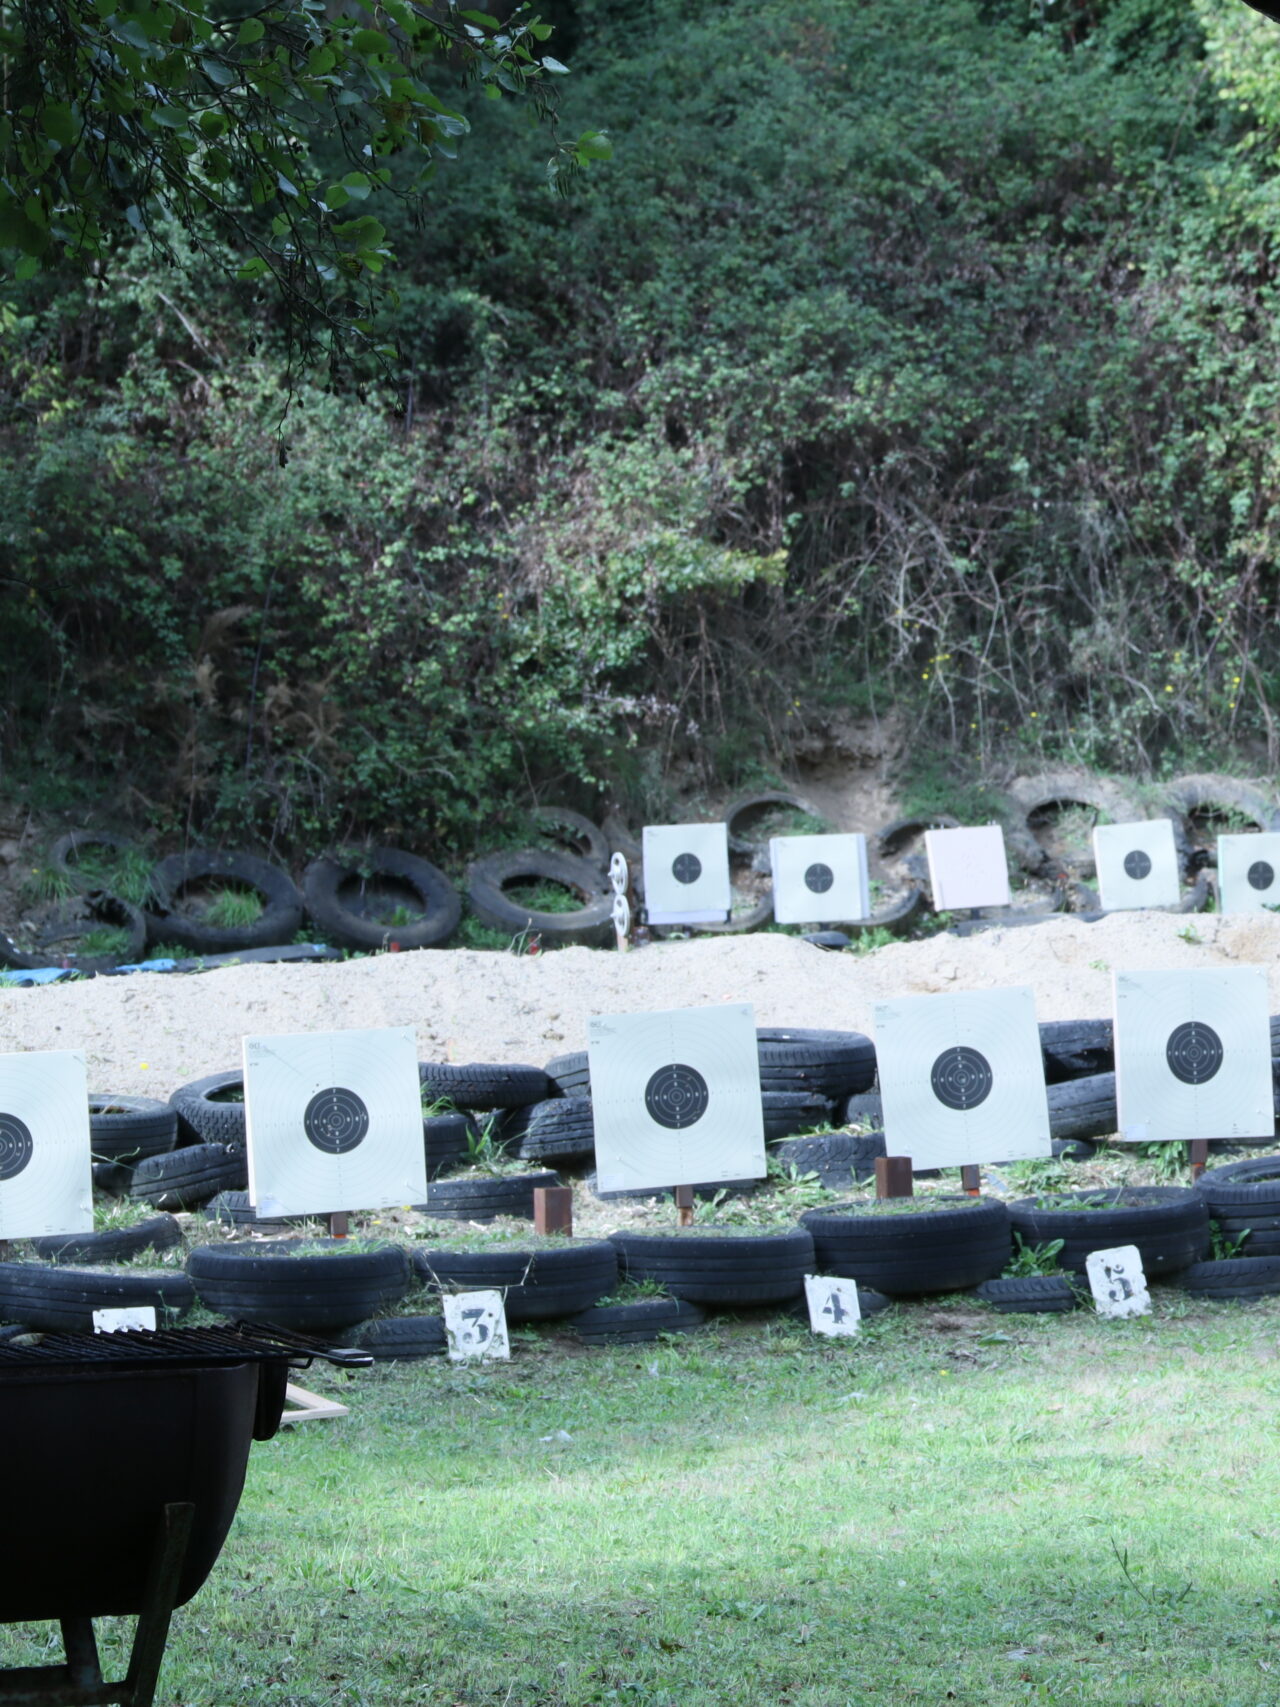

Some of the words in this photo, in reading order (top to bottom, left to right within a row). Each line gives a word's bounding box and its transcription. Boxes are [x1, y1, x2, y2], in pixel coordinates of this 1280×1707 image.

[1104, 1264, 1134, 1302] 5
[460, 1307, 490, 1345] 3
[822, 1291, 849, 1325] 4
